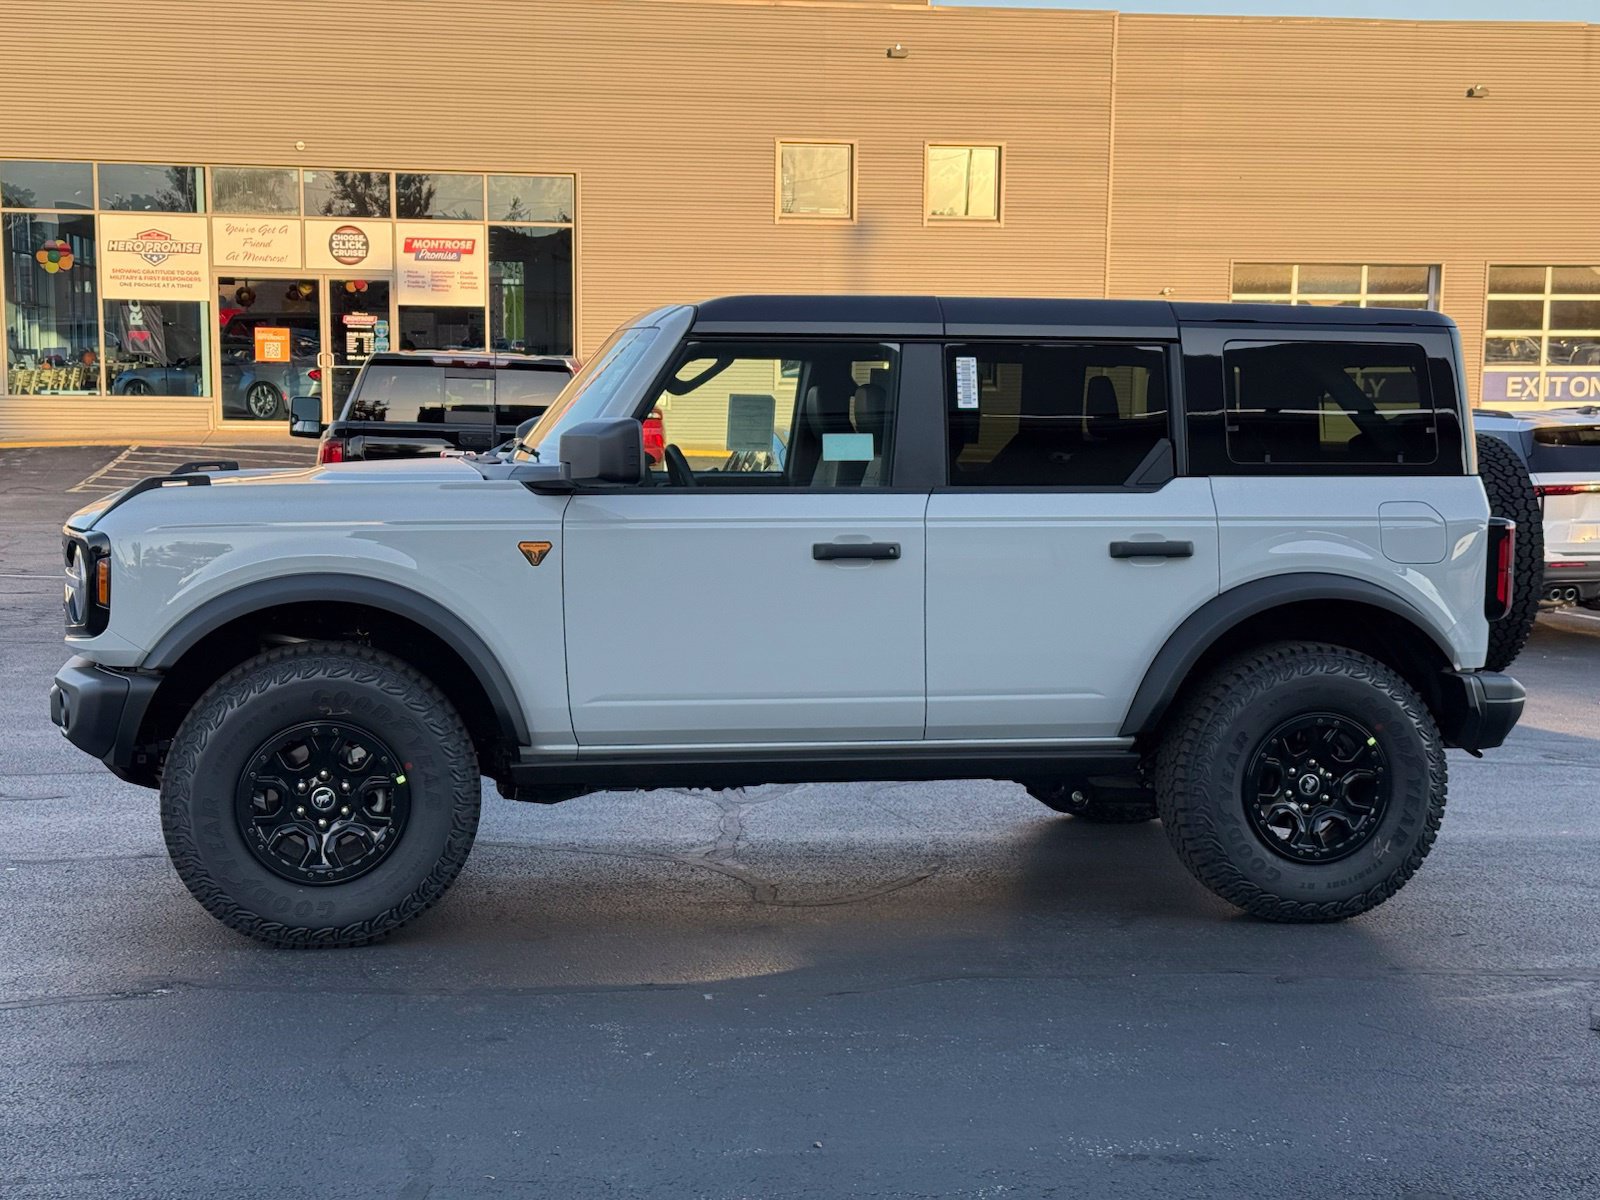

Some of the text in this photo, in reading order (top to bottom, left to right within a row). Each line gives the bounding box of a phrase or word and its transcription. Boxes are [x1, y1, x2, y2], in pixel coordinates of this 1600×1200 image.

[225, 223, 289, 235] You've Got A
[107, 240, 203, 255] HERO PROMISE
[242, 237, 273, 248] Friend
[411, 239, 473, 250] MONTROSE
[225, 251, 289, 263] At Montrose!
[331, 249, 367, 258] CRUISE!
[418, 248, 459, 261] Promise
[1506, 376, 1568, 397] EXIT
